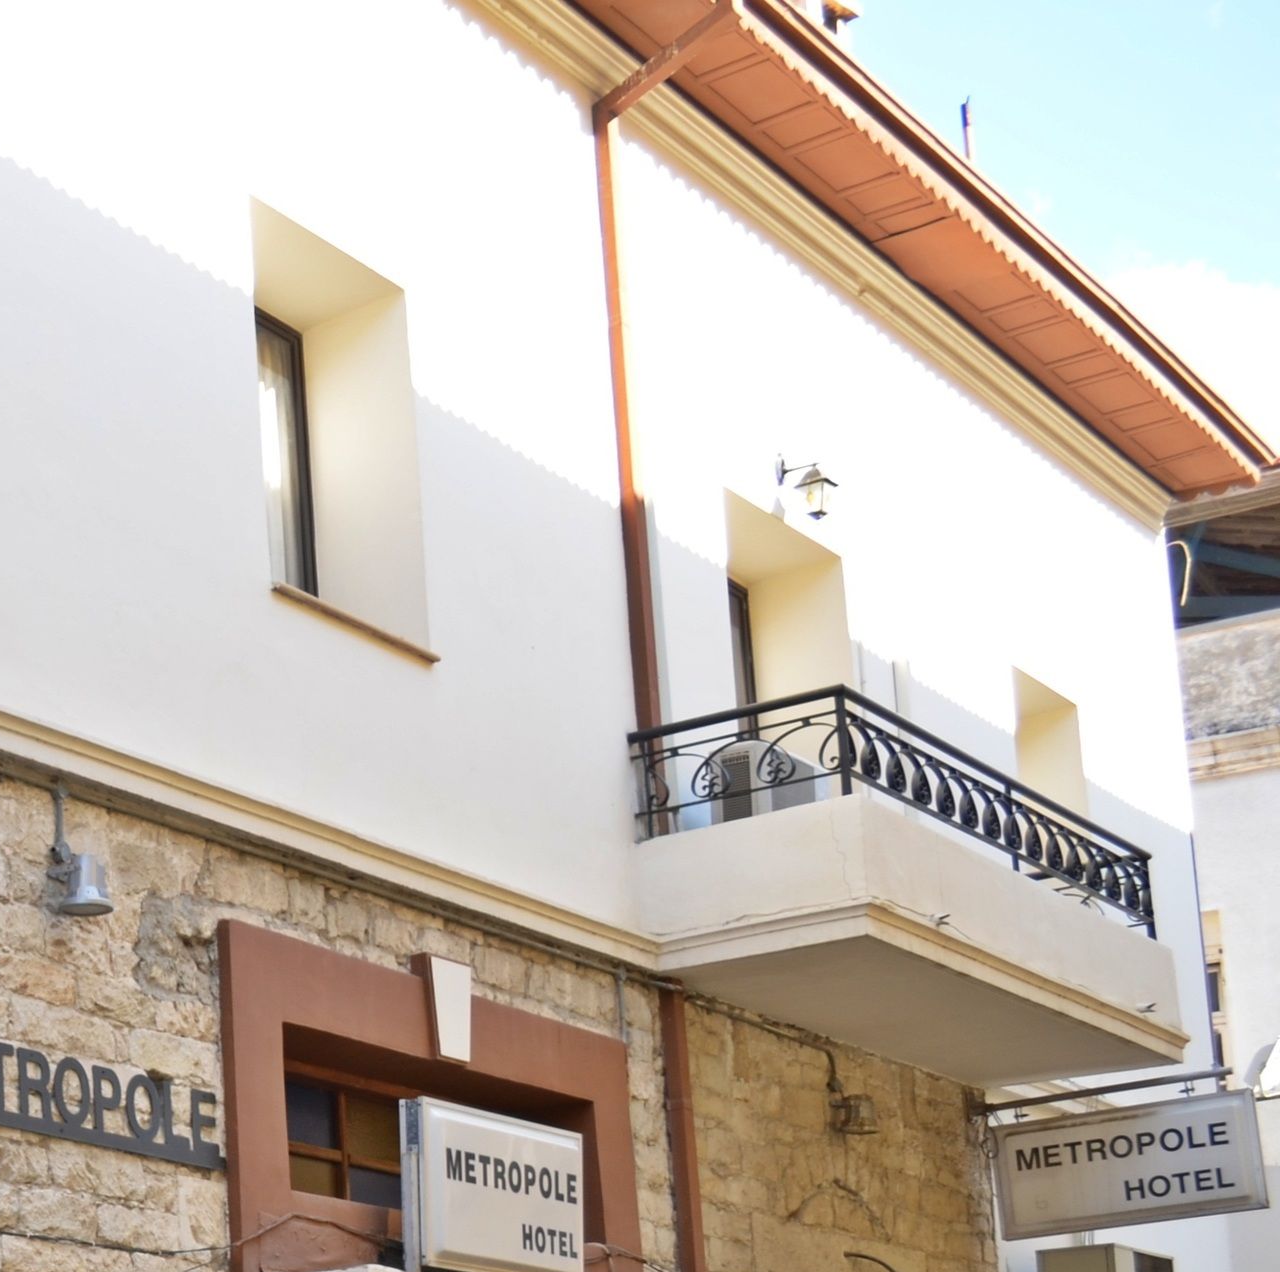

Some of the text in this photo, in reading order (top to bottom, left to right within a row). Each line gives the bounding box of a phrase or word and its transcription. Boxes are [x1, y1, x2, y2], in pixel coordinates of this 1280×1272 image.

[1015, 1121, 1230, 1172] METROPOLE
[445, 1147, 578, 1205] METROPOLE
[1123, 1167, 1235, 1201] HOTEL
[521, 1223, 578, 1259] HOTEL
